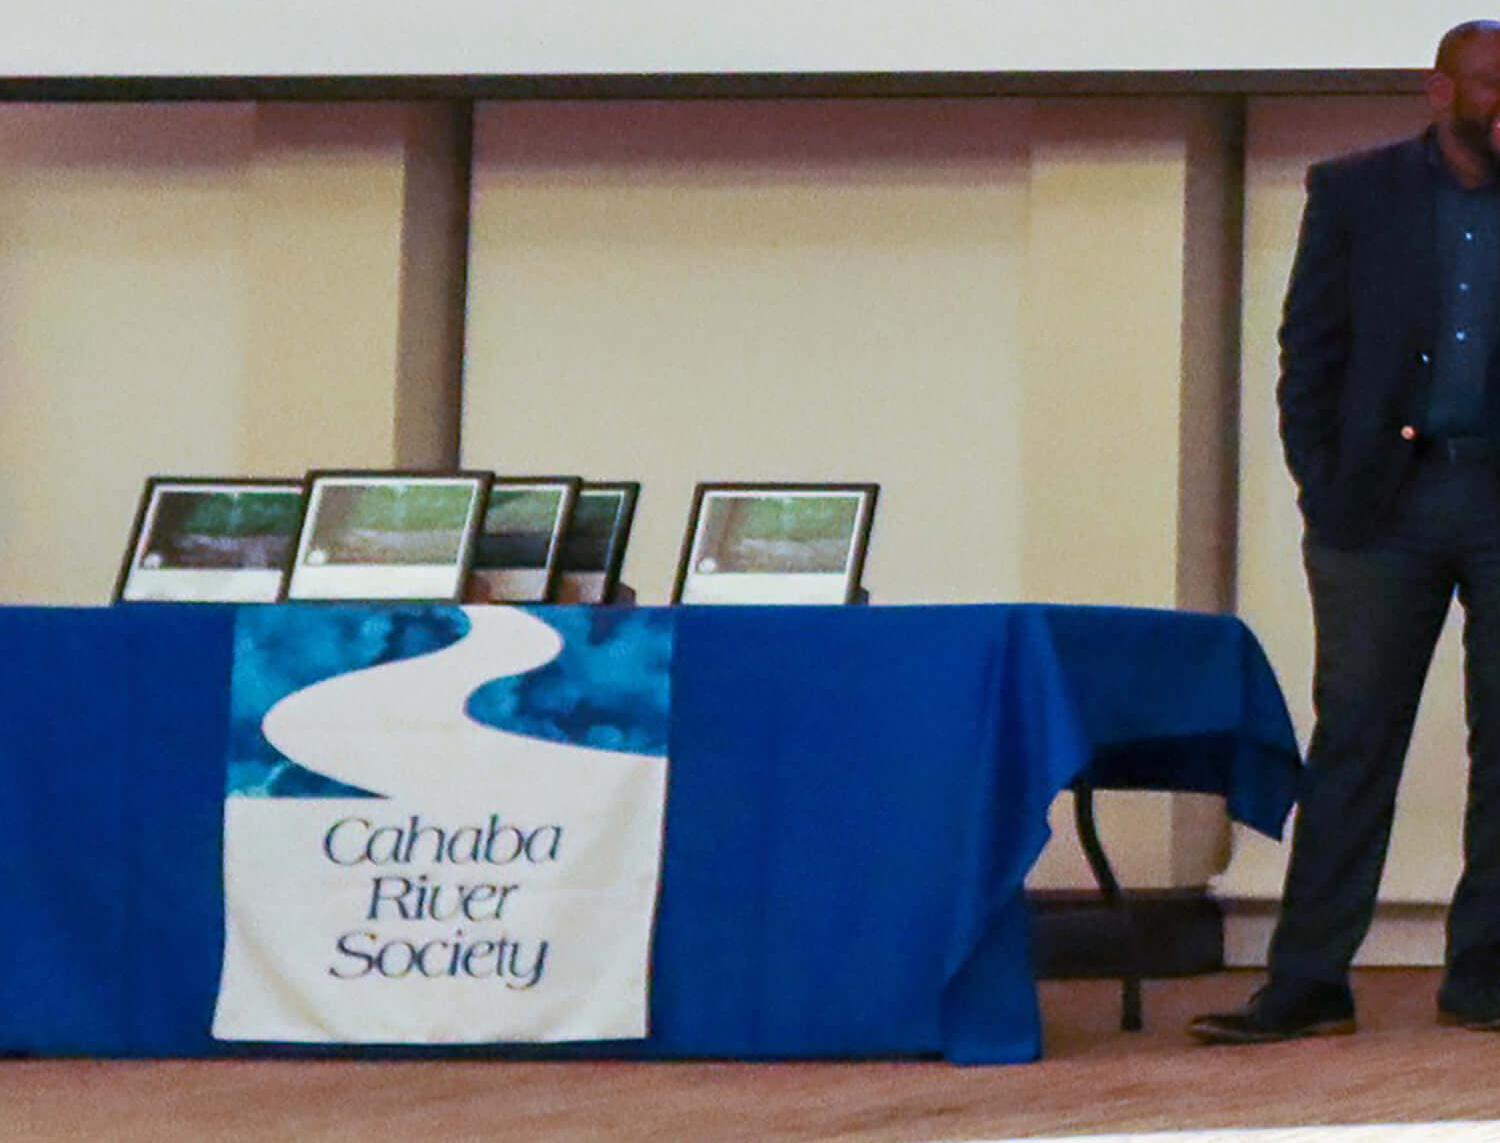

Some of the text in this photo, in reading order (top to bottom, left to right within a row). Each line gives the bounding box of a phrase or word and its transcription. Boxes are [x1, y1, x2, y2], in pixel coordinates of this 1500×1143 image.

[324, 814, 562, 866] Cahaba
[366, 874, 519, 922] River
[327, 927, 549, 990] Society
